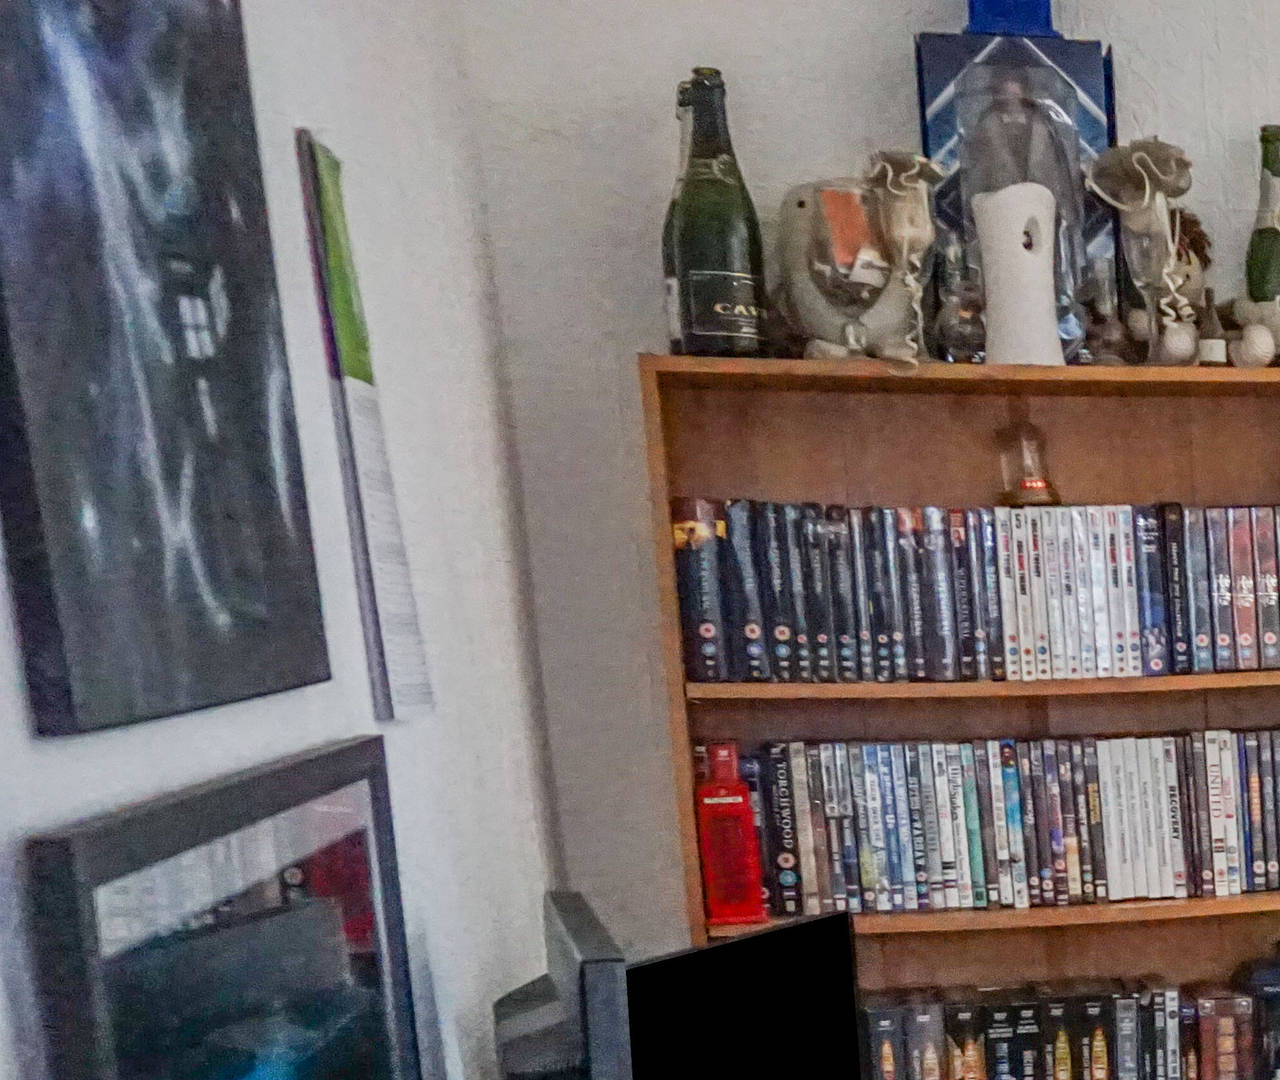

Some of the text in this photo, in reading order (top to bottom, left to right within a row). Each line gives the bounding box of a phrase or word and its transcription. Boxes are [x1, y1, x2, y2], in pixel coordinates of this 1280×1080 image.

[776, 762, 794, 849] TORCHWOOD
[1168, 785, 1180, 840] RECOVERY
[1208, 763, 1221, 818] UNITED
